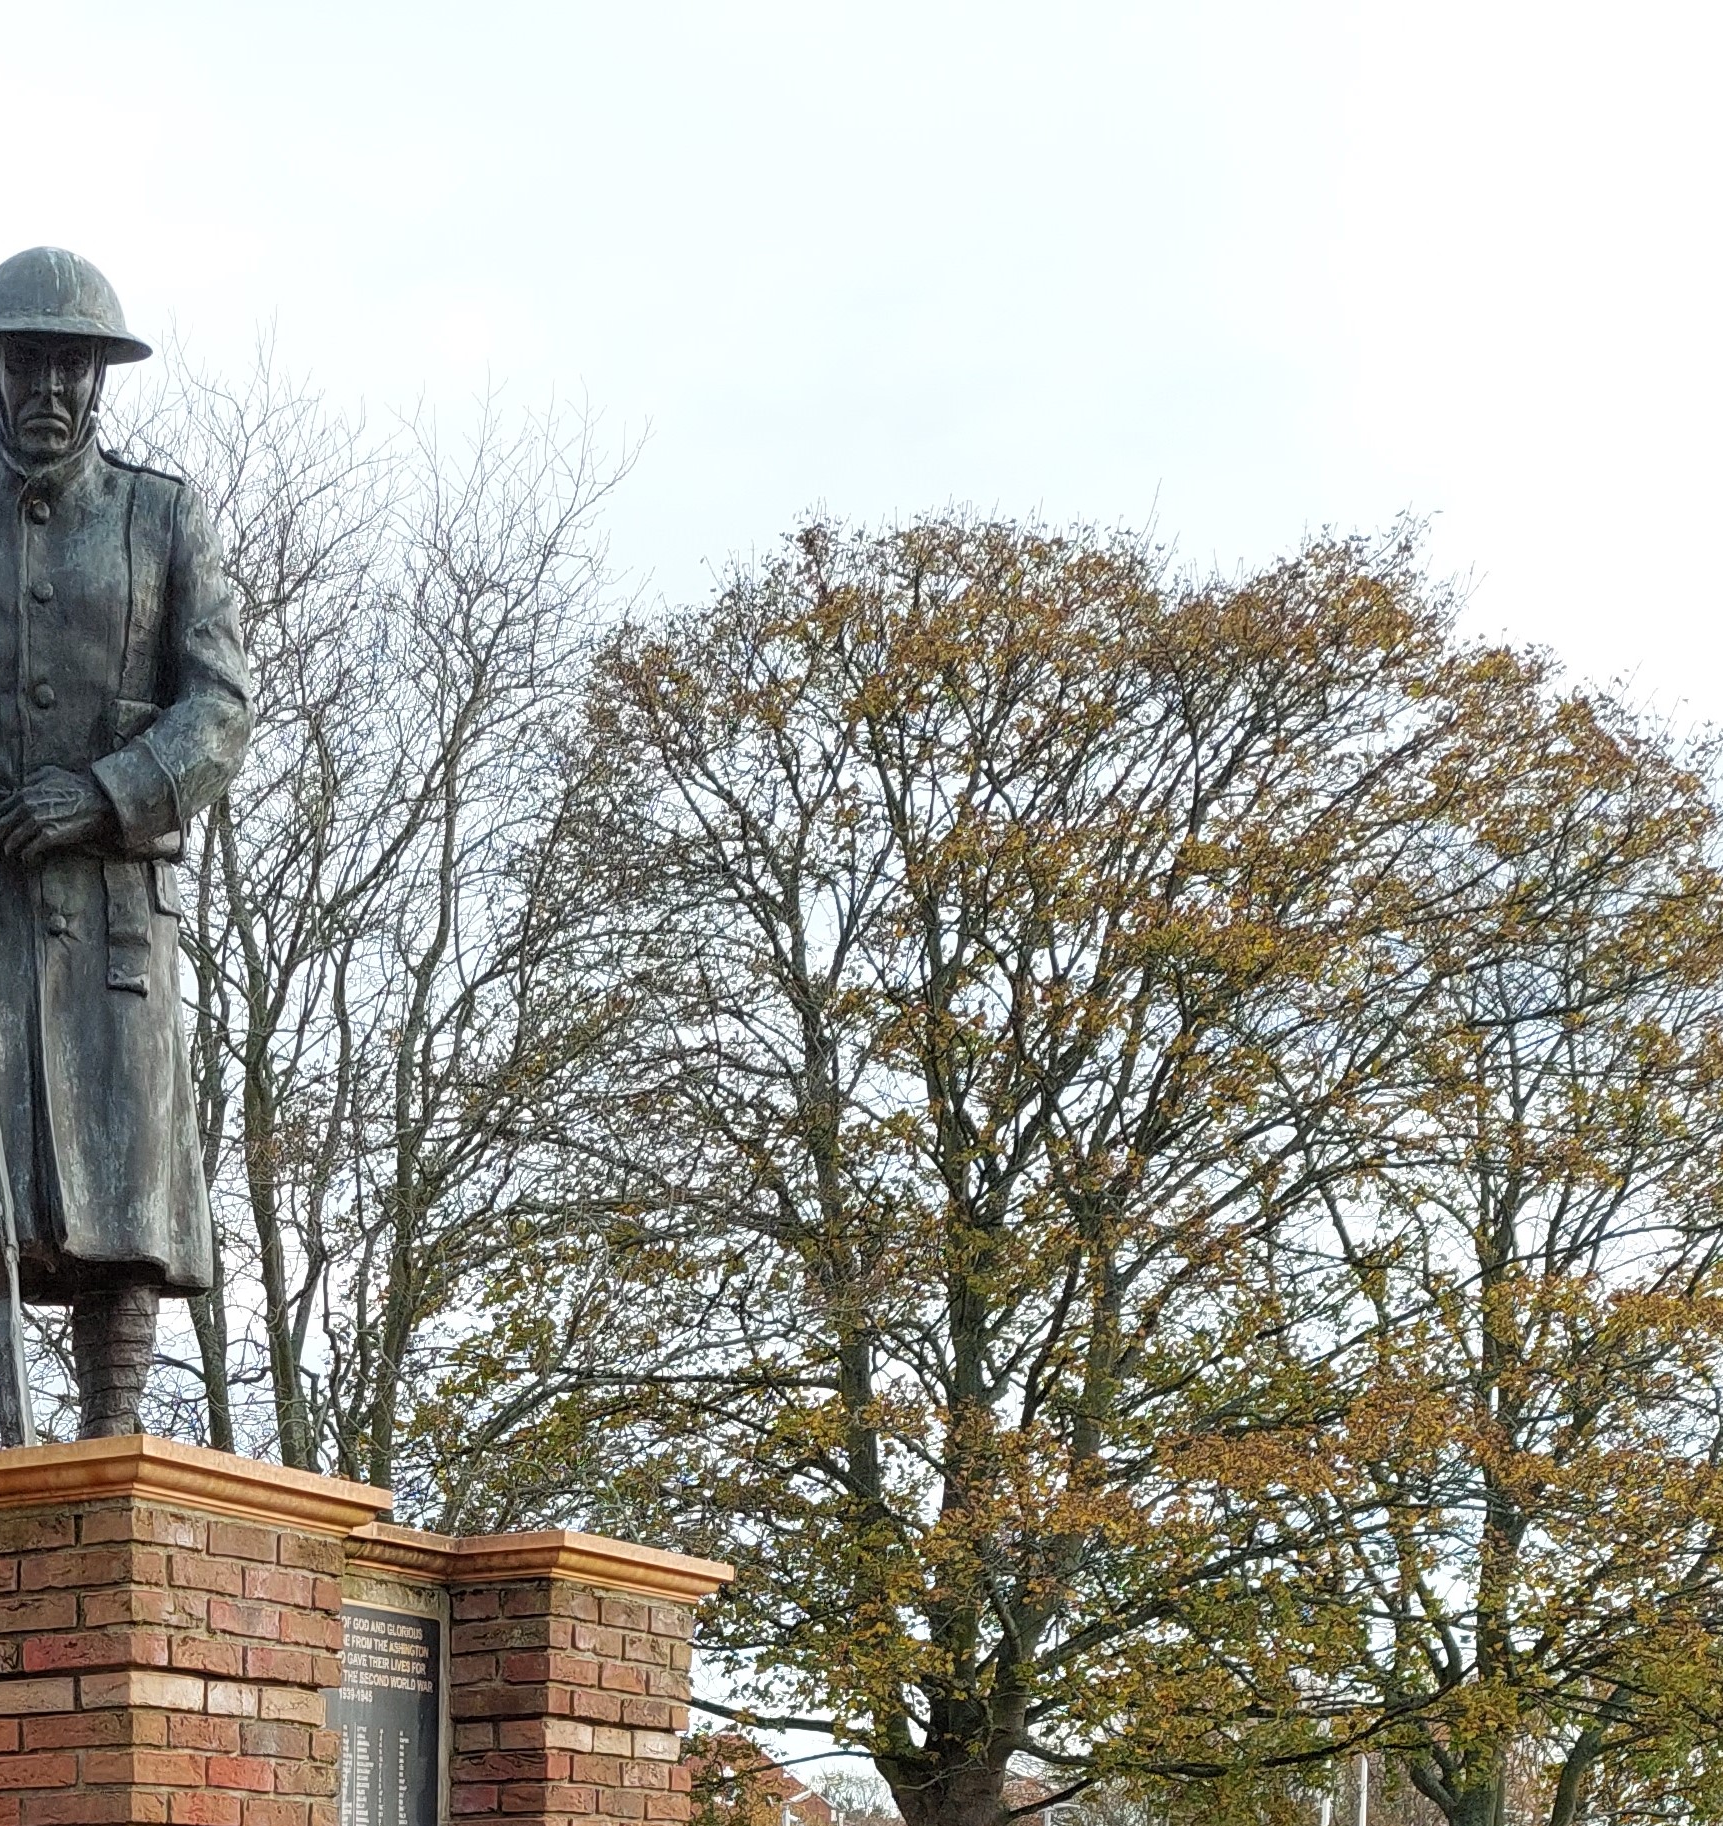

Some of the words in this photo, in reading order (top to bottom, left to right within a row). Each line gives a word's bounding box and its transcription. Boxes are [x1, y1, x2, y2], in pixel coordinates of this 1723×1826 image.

[352, 1617, 370, 1632] GOD
[370, 1620, 386, 1635] AND
[387, 1623, 424, 1641] GLORIOUS
[351, 1634, 373, 1650] FROM
[373, 1638, 389, 1653] THE
[389, 1641, 430, 1659] ASHINGTON
[347, 1652, 369, 1668] GAVE
[369, 1655, 390, 1671] THEIR
[390, 1657, 411, 1674] LIVES
[411, 1661, 427, 1676] FOR
[342, 1669, 359, 1683] THE
[359, 1671, 390, 1687] SECOND
[390, 1675, 416, 1691] WORLD
[416, 1679, 434, 1694] WAR
[338, 1687, 373, 1704] 1939-1945
